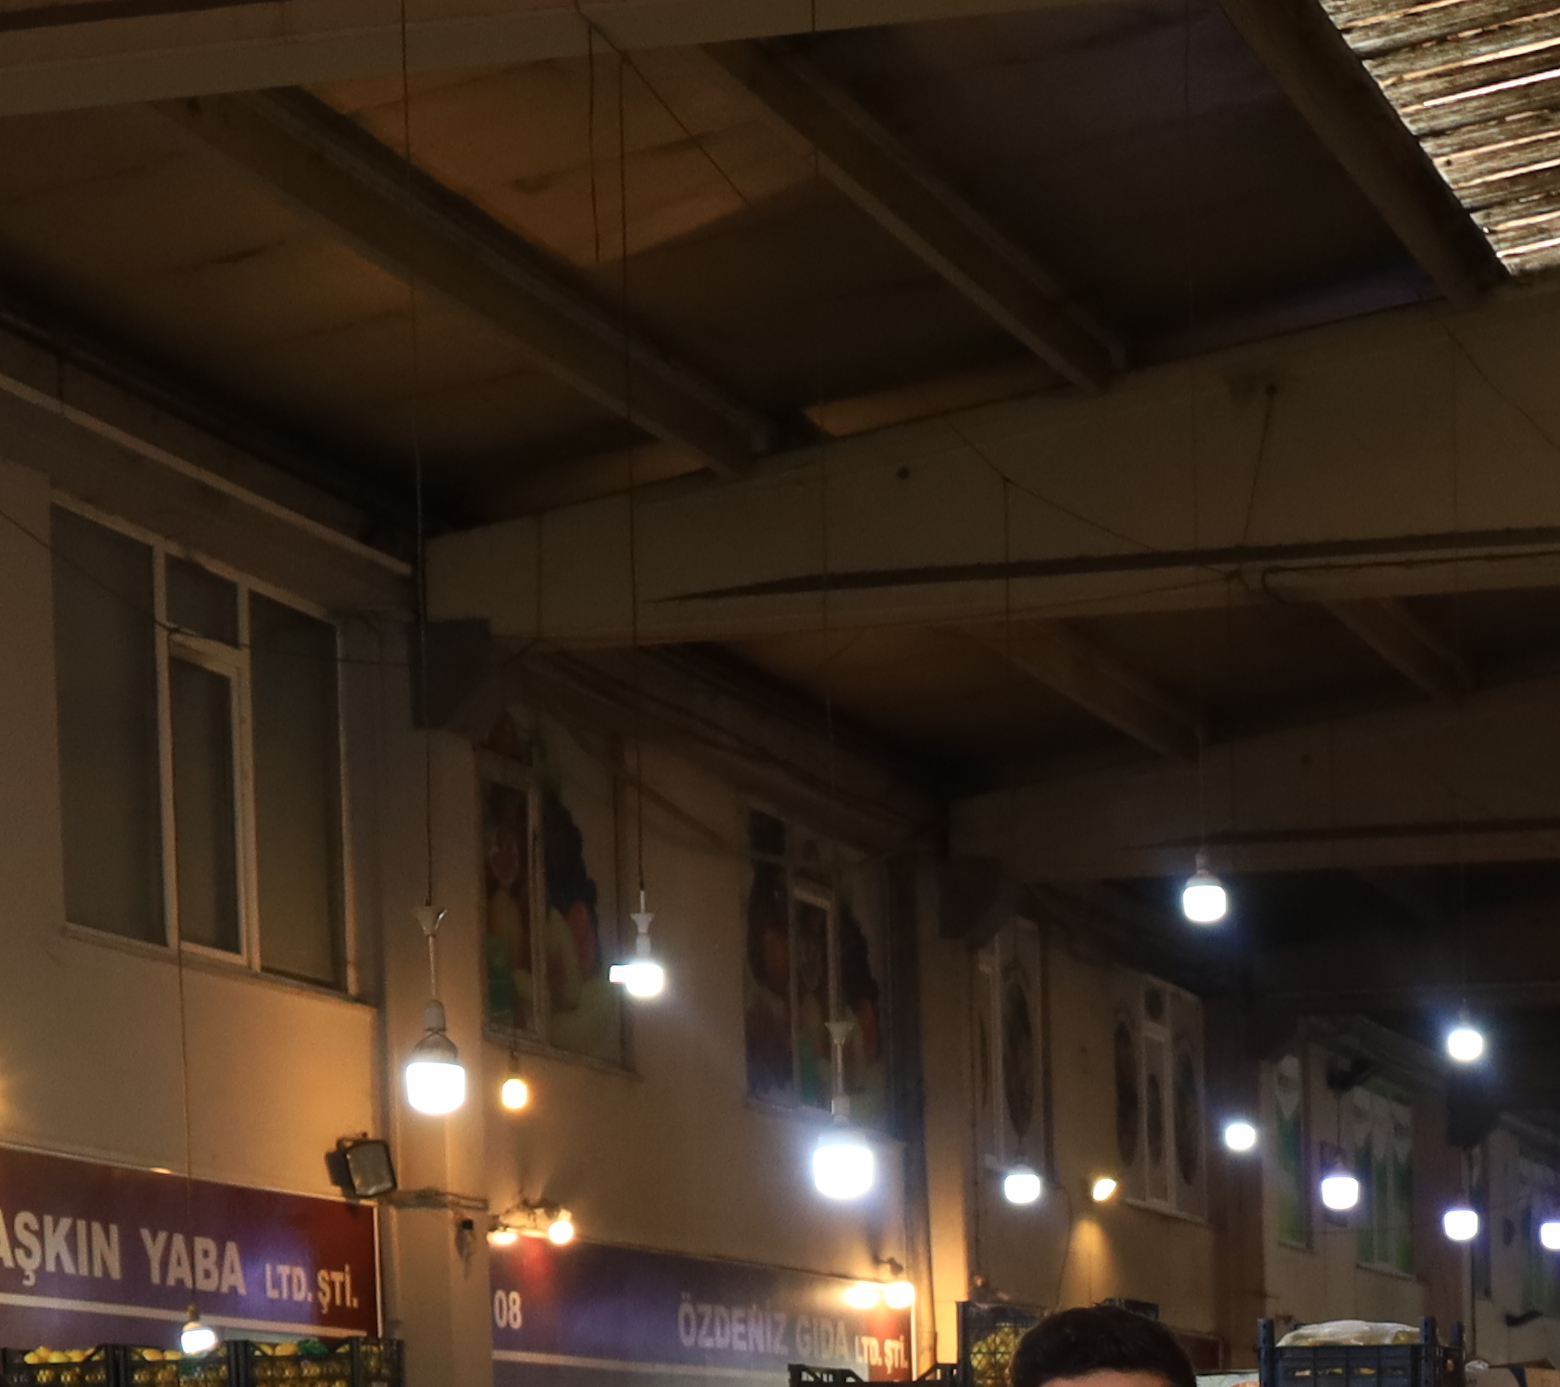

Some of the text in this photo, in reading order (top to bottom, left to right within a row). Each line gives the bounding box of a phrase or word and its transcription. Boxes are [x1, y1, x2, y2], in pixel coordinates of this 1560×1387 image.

[139, 1228, 247, 1297] YABA
[265, 1263, 313, 1303] LTD.
[317, 1263, 359, 1314] ŞTİ.
[493, 1289, 523, 1331] 08
[677, 1291, 790, 1356] ÖZDENİZ
[795, 1313, 851, 1361] GIDA
